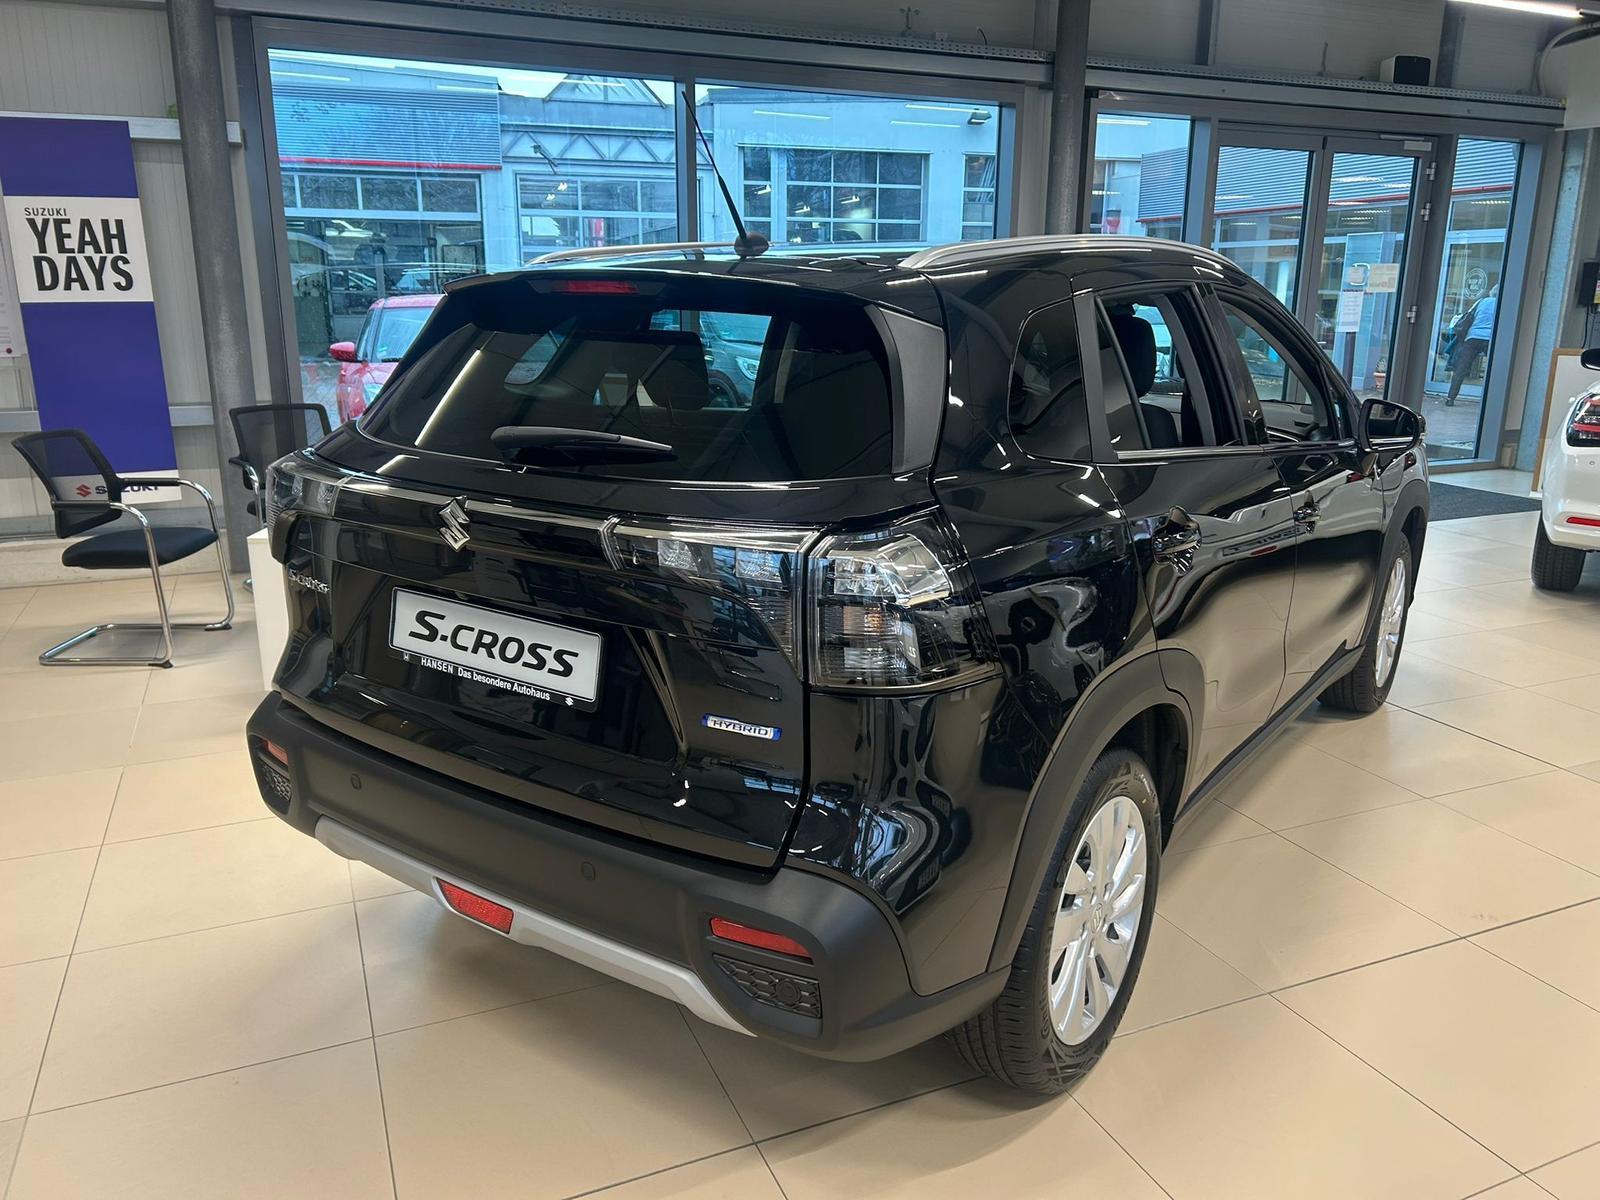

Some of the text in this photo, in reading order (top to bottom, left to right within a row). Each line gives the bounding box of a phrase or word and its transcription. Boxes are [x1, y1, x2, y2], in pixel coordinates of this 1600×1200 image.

[24, 207, 67, 217] SUZUKI
[25, 217, 128, 254] YEAH
[32, 255, 134, 291] DAYS
[95, 483, 159, 495] SZUKI
[421, 656, 550, 701] HANSEN Das besondere Autohaus
[712, 719, 768, 736] HYBRID
